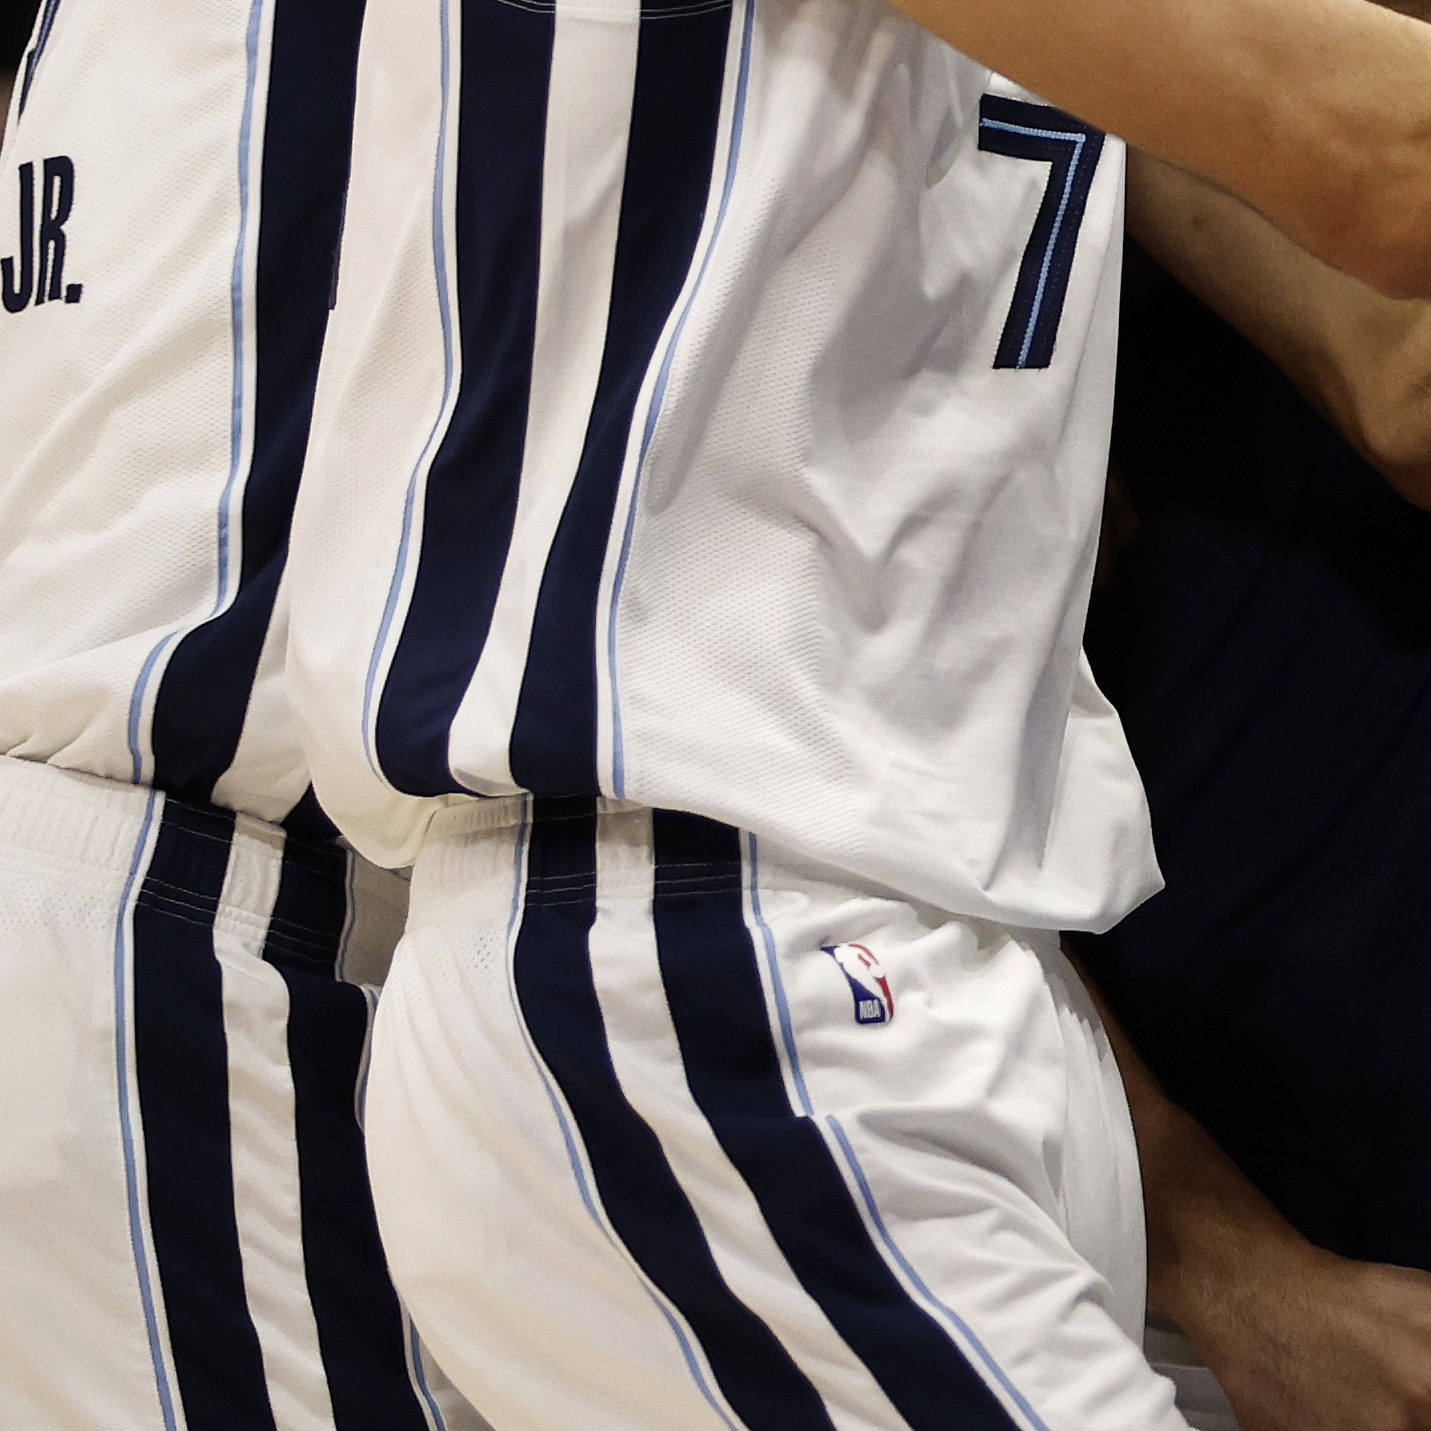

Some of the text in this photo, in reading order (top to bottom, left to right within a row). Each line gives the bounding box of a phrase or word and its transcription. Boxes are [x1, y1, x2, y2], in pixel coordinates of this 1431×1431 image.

[1, 156, 82, 313] JR.
[978, 92, 1106, 370] 7
[859, 998, 881, 1020] NBA
